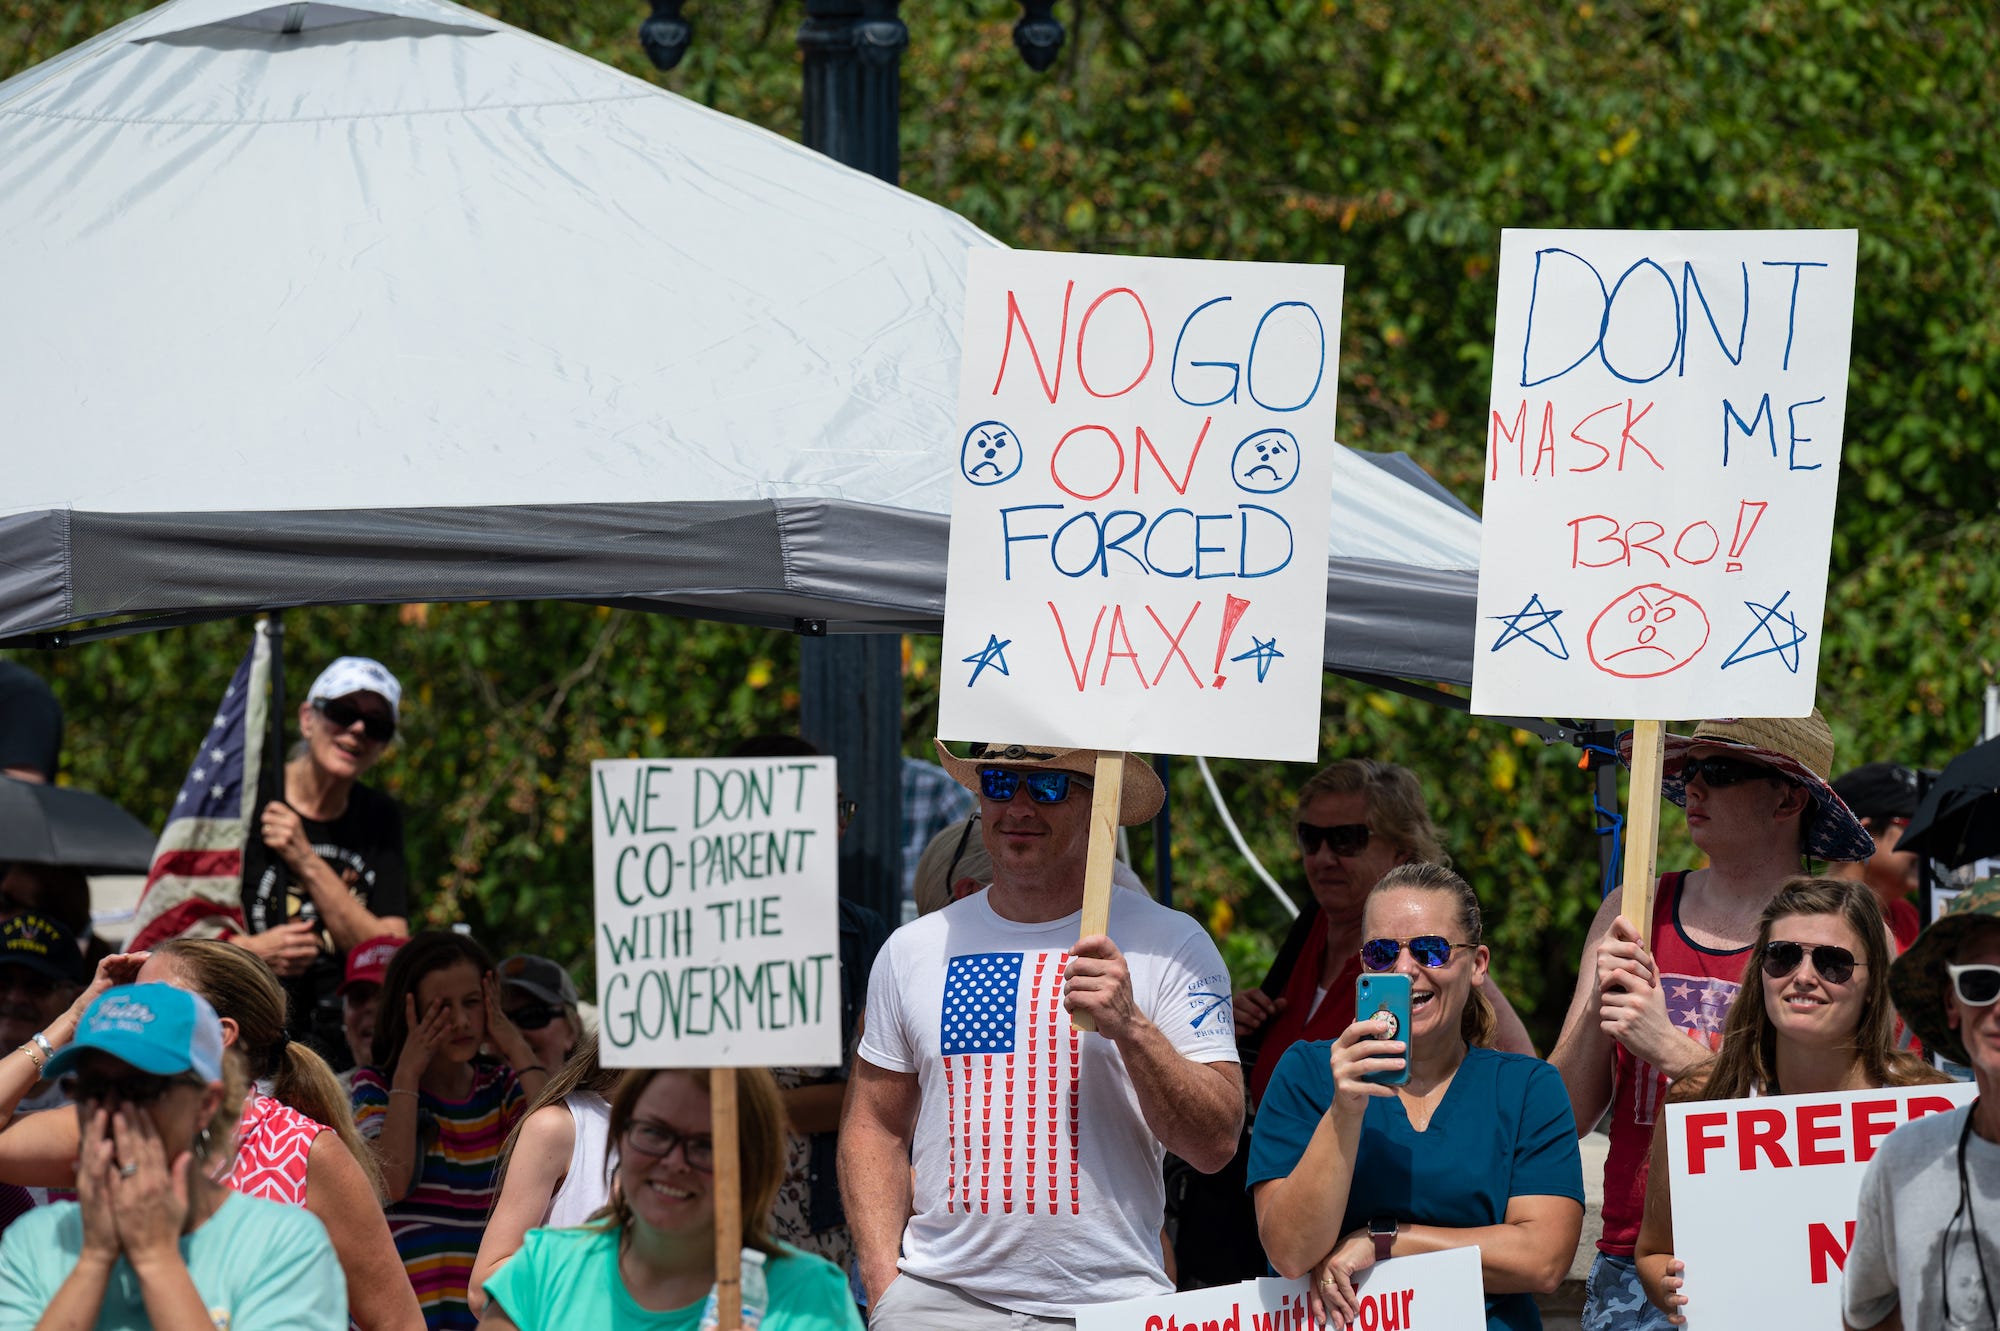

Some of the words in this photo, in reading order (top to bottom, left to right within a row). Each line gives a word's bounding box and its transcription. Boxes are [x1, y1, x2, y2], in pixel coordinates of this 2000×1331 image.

[992, 279, 1154, 404] NO
[1171, 296, 1325, 413] GO
[1520, 248, 1829, 388] DONT
[1050, 416, 1212, 501] ON
[1492, 398, 1664, 480] MASK
[1722, 393, 1826, 471] ME
[999, 503, 1294, 581] FORCED
[1567, 499, 1769, 573] BRO!
[1047, 593, 1251, 692] VAX!
[598, 766, 676, 836] WE
[694, 765, 817, 829] DON'T
[616, 830, 816, 906] CO-PARENT
[603, 908, 693, 965] WITH
[706, 896, 782, 942] THE
[605, 954, 833, 1048] GOVERMENT
[1685, 1095, 1980, 1175] FREE
[1346, 1283, 1415, 1331] our
